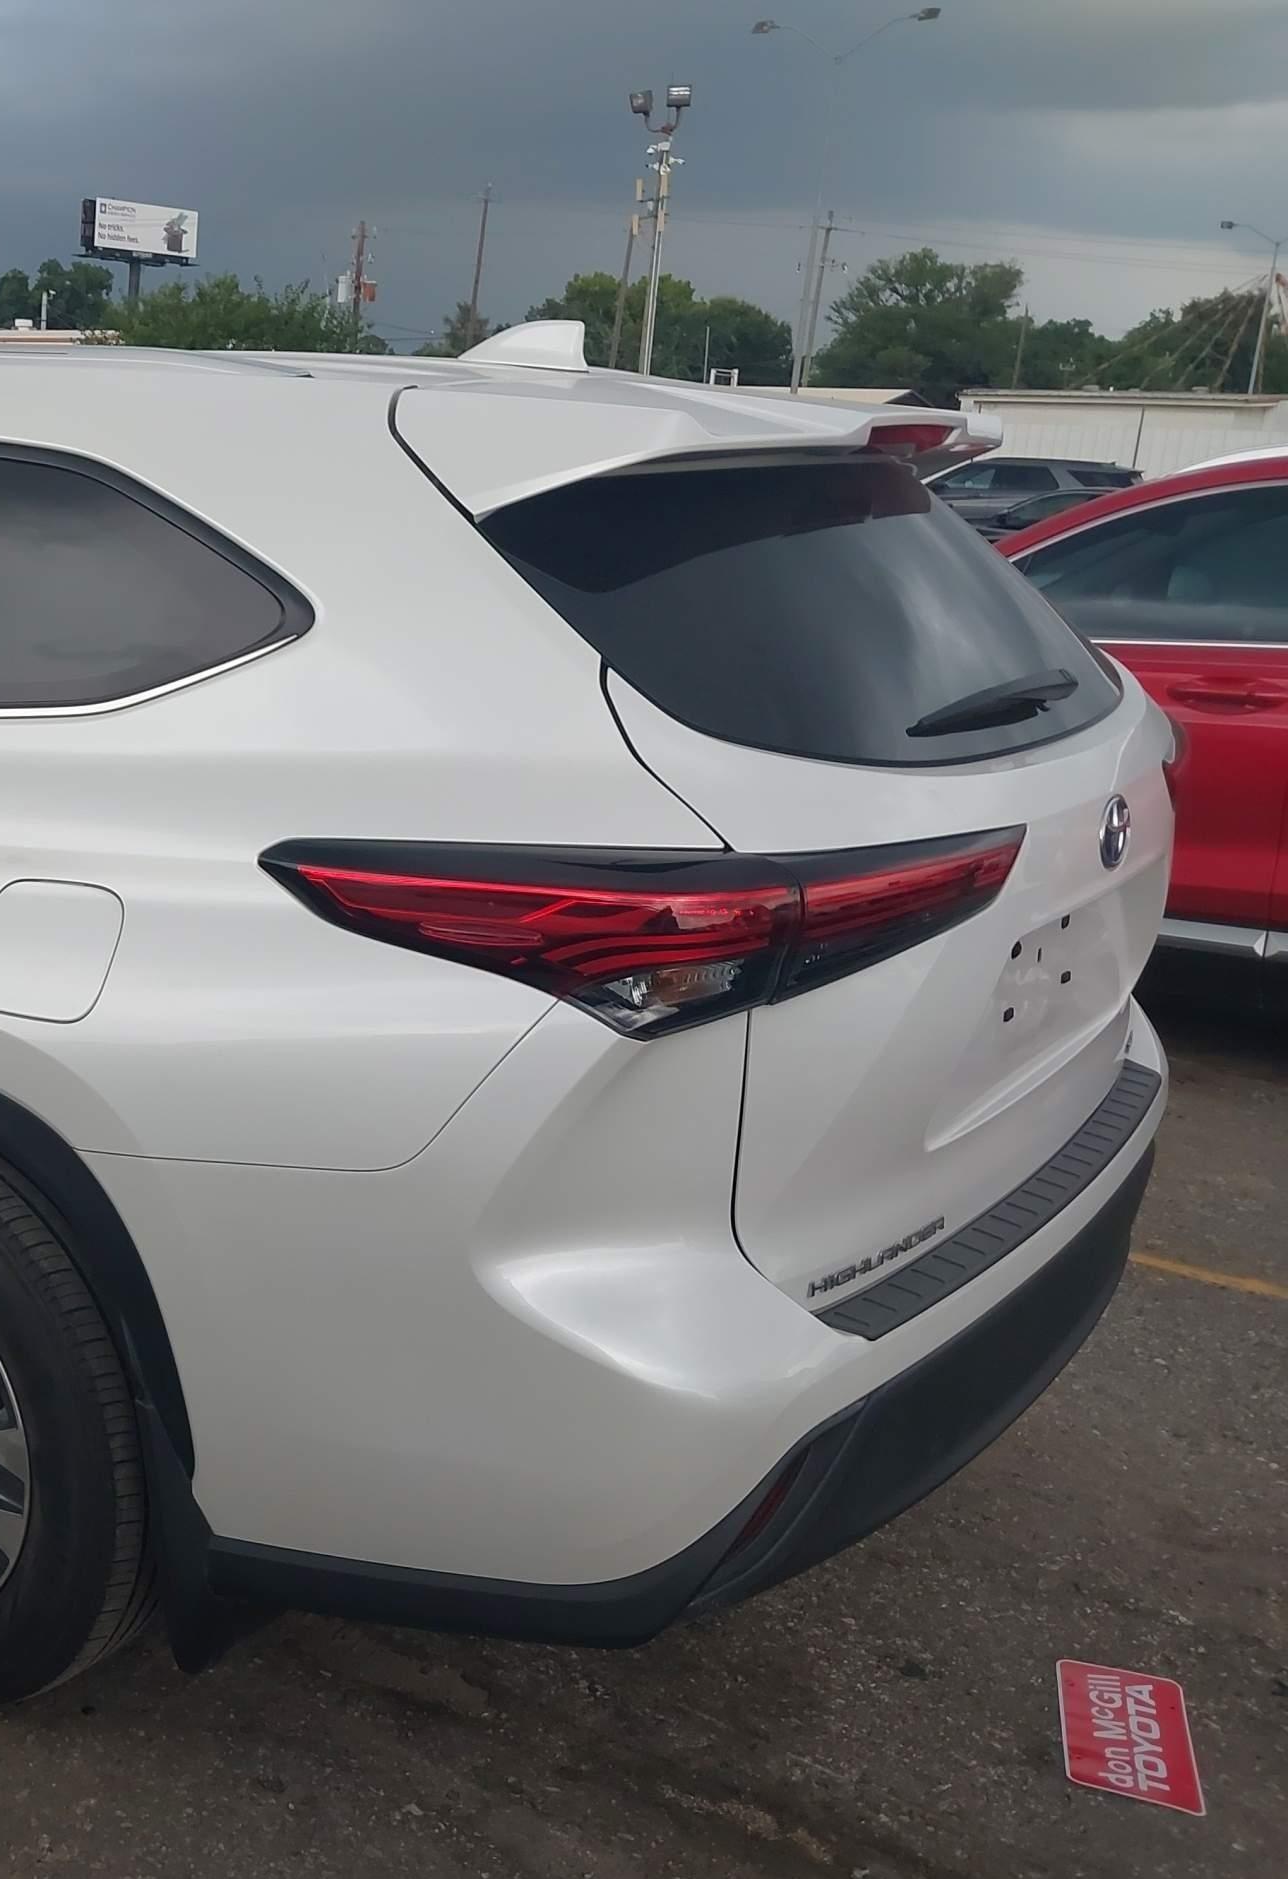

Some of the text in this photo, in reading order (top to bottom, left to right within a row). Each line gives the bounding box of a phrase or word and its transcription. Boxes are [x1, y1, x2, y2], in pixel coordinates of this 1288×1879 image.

[97, 232, 107, 240] No
[107, 232, 126, 241] hidden
[98, 222, 107, 230] No
[807, 1216, 945, 1298] HIGHLANDER
[1124, 1684, 1171, 1792] TOYOTA
[1098, 1746, 1135, 1788] don
